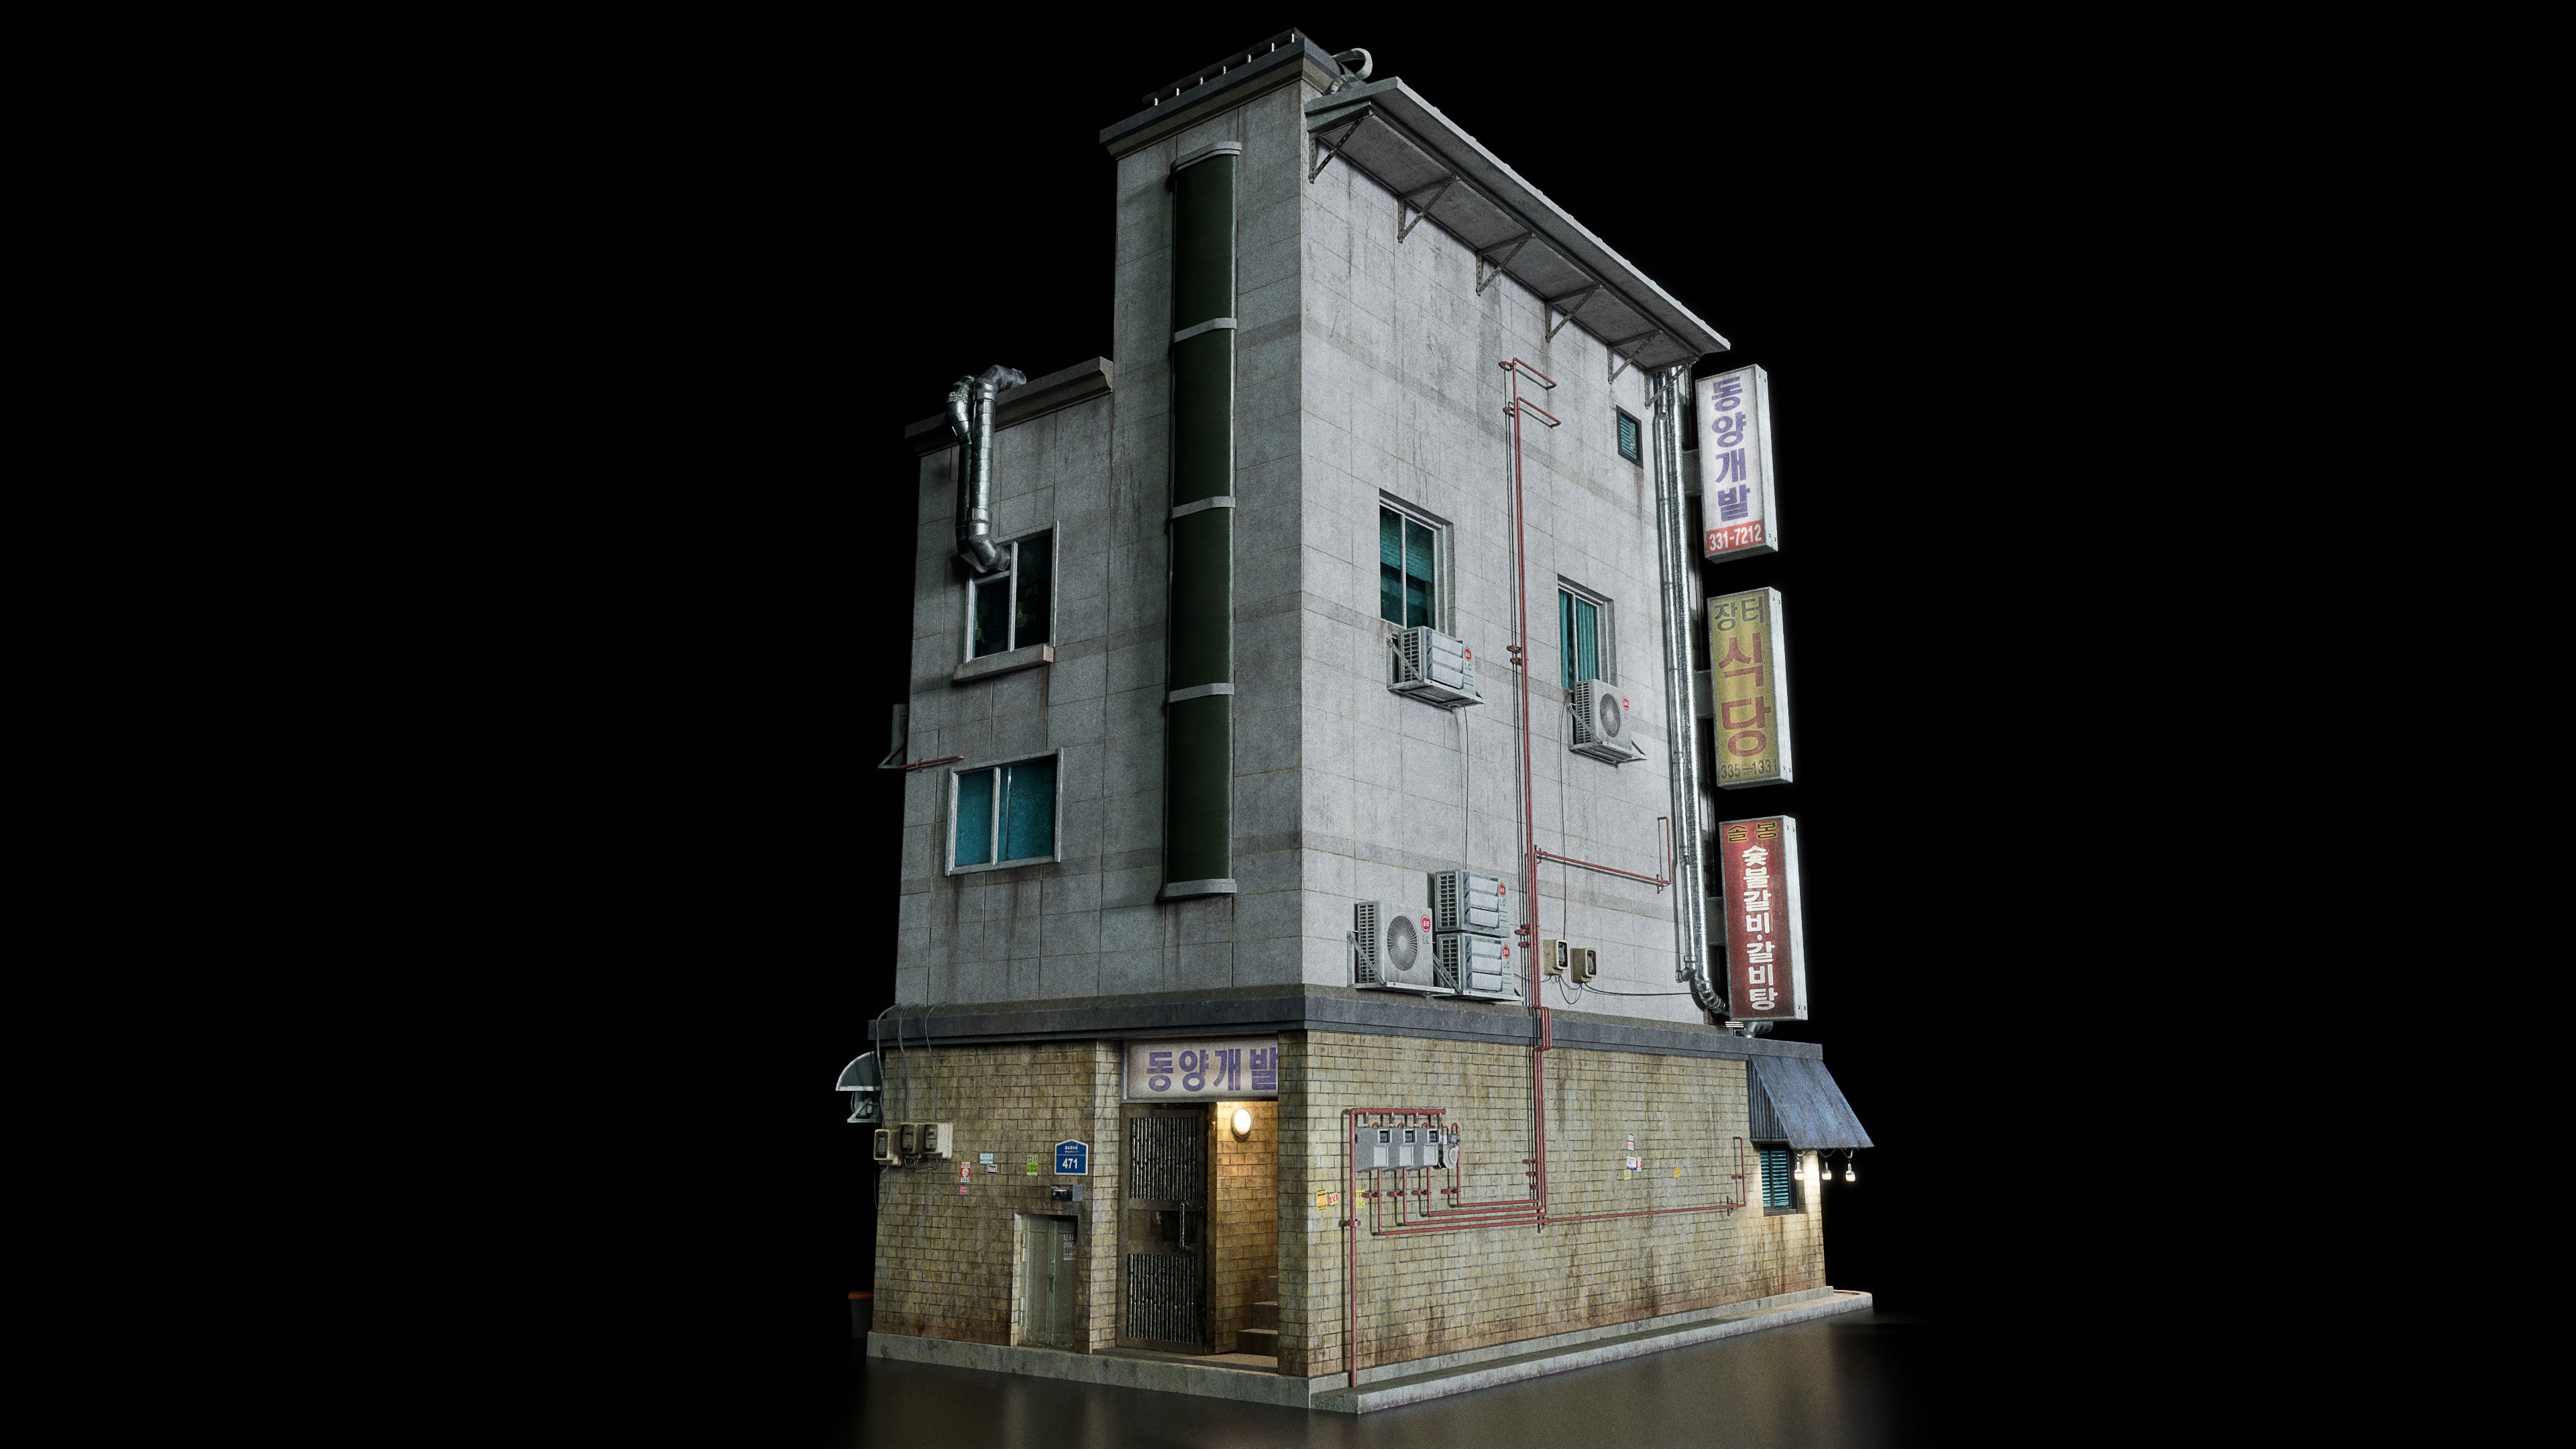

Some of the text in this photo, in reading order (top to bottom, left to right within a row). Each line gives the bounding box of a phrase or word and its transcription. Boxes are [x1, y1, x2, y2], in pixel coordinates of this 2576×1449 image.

[1711, 376, 1750, 522] 동양개발
[1709, 523, 1762, 551] 331-7212
[1714, 595, 1764, 631] 장터
[1718, 632, 1772, 757] 식당
[1146, 1046, 1278, 1092] 동양개발
[1062, 1158, 1078, 1169] 471
